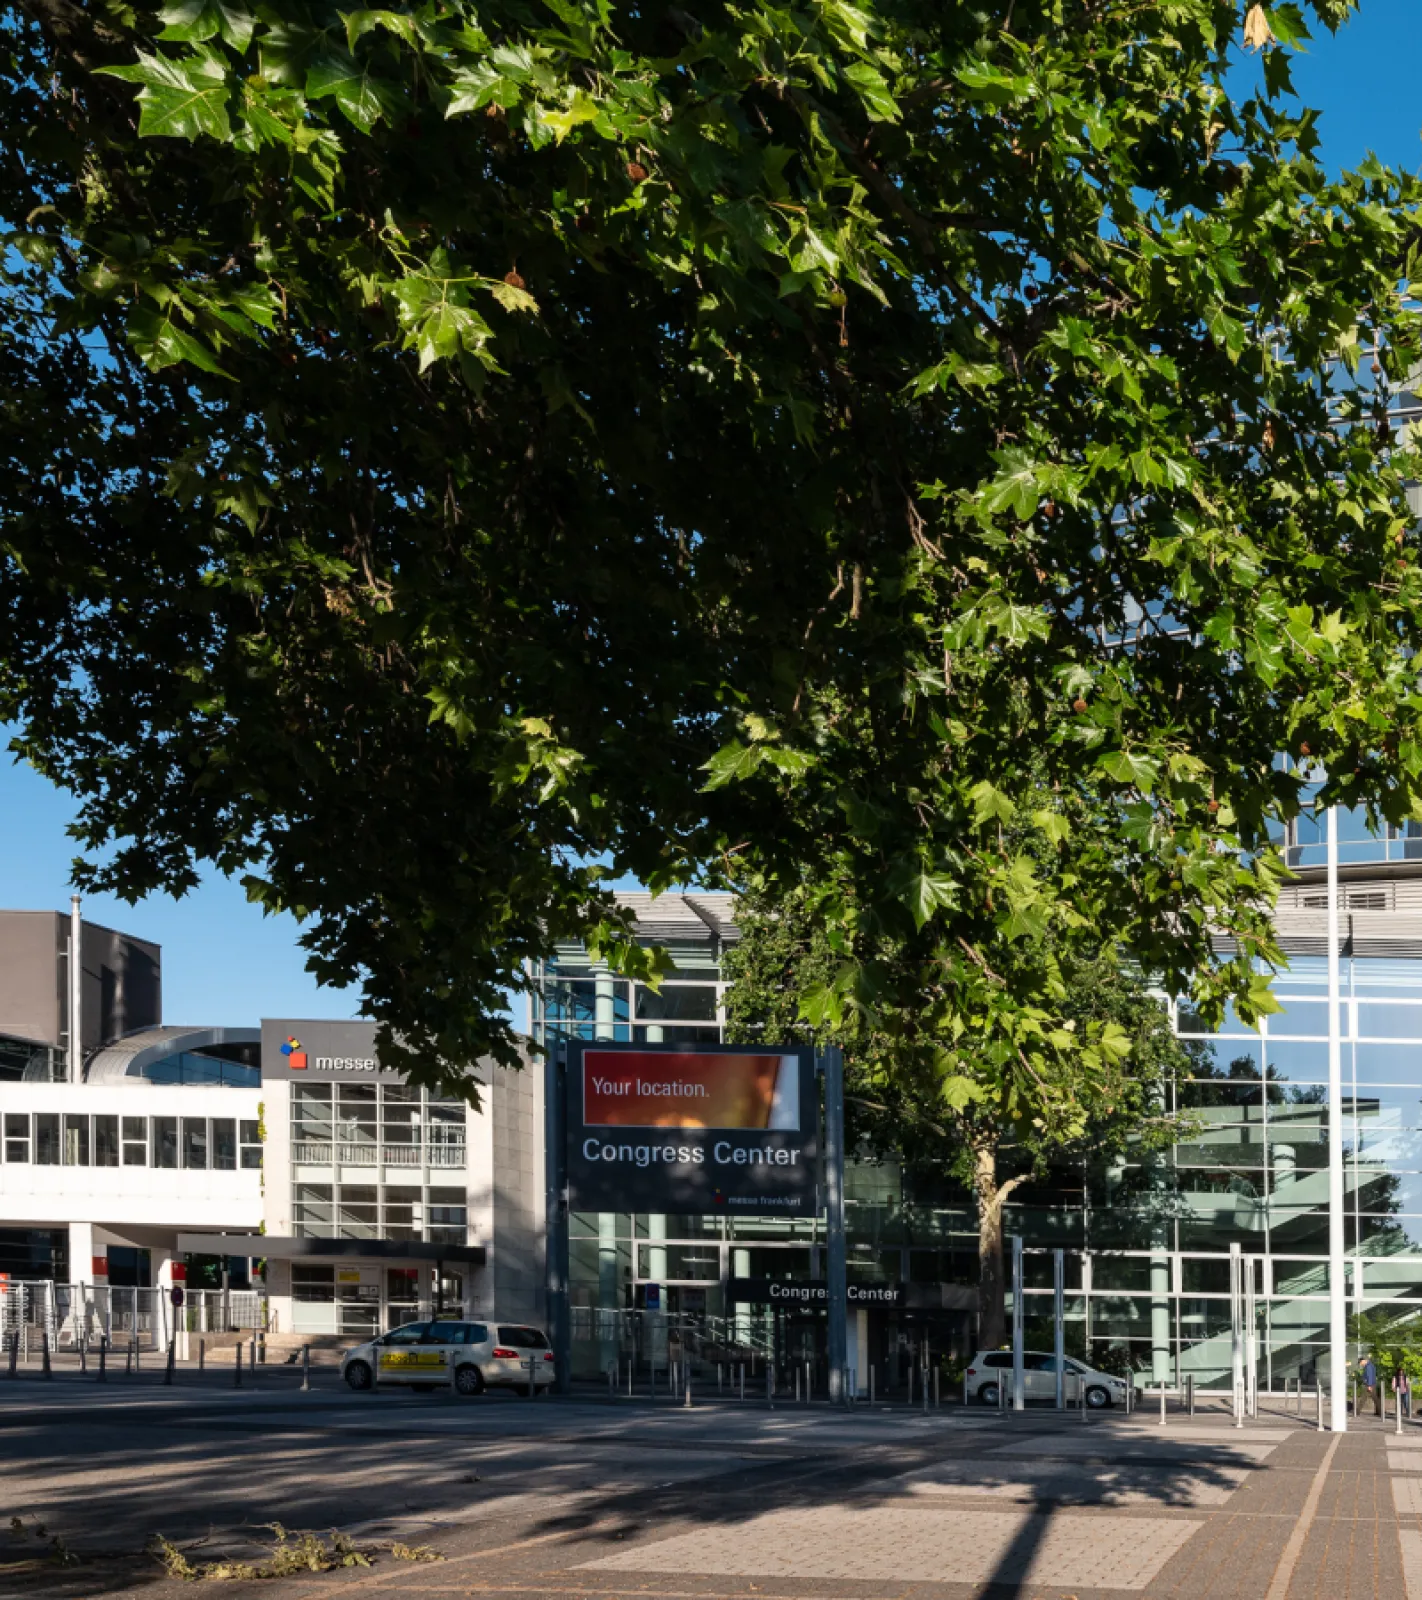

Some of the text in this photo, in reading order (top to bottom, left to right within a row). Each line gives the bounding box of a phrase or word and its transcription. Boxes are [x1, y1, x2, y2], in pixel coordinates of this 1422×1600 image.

[316, 1057, 375, 1070] messe
[592, 1077, 710, 1098] Your location.
[583, 1138, 800, 1167] Congress Center
[769, 1284, 899, 1300] Congre Center
